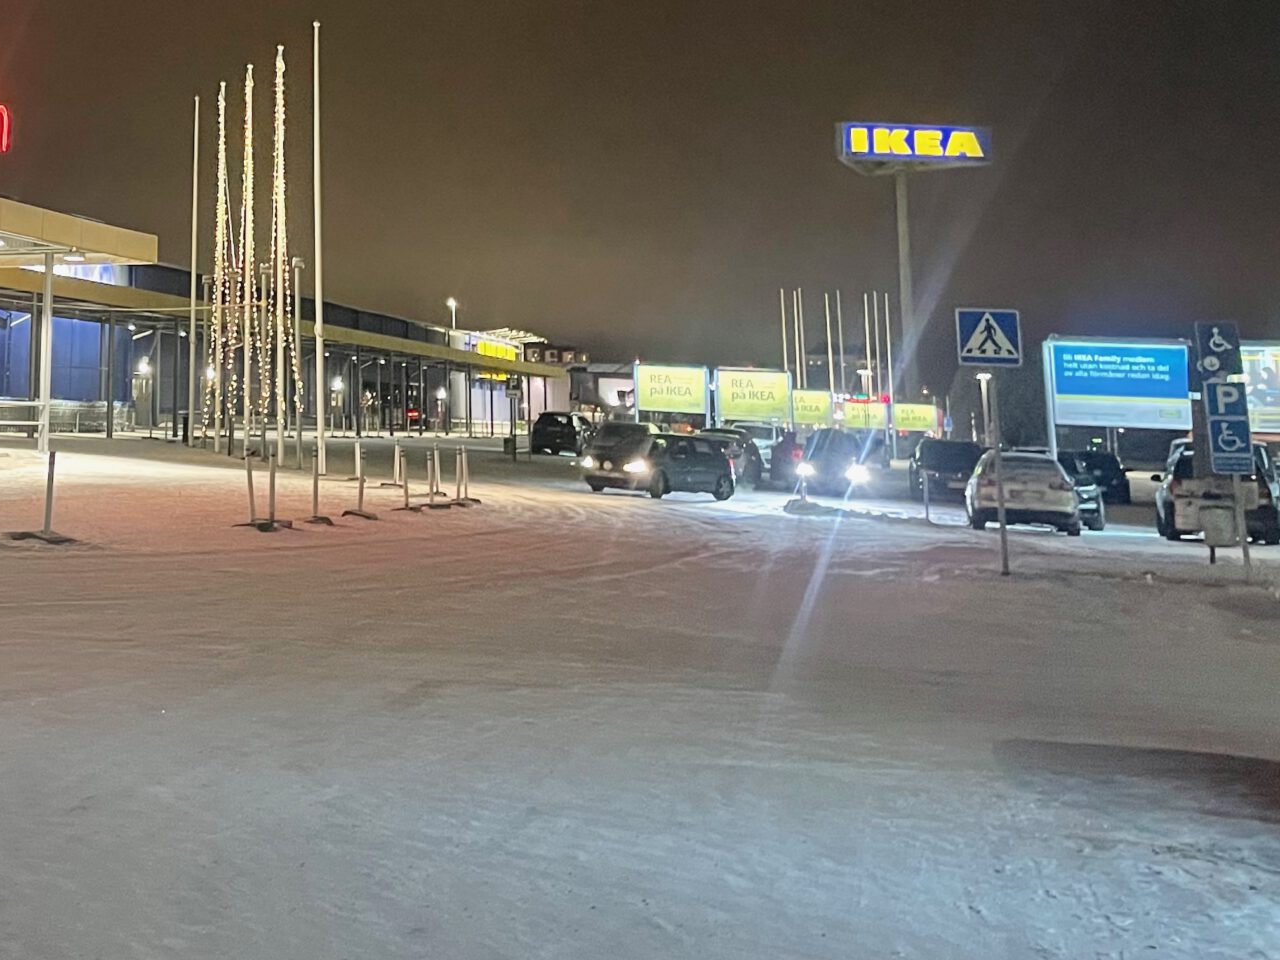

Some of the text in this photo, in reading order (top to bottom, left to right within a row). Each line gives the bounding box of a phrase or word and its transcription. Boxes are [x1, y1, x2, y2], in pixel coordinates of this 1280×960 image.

[850, 127, 985, 158] IKEA
[1094, 354, 1121, 363] Family
[649, 374, 671, 384] REA
[731, 378, 754, 389] REA
[666, 386, 692, 397] IKEA
[731, 389, 776, 401] på IKEA
[1216, 385, 1239, 414] P
[801, 404, 821, 413] IKEA
